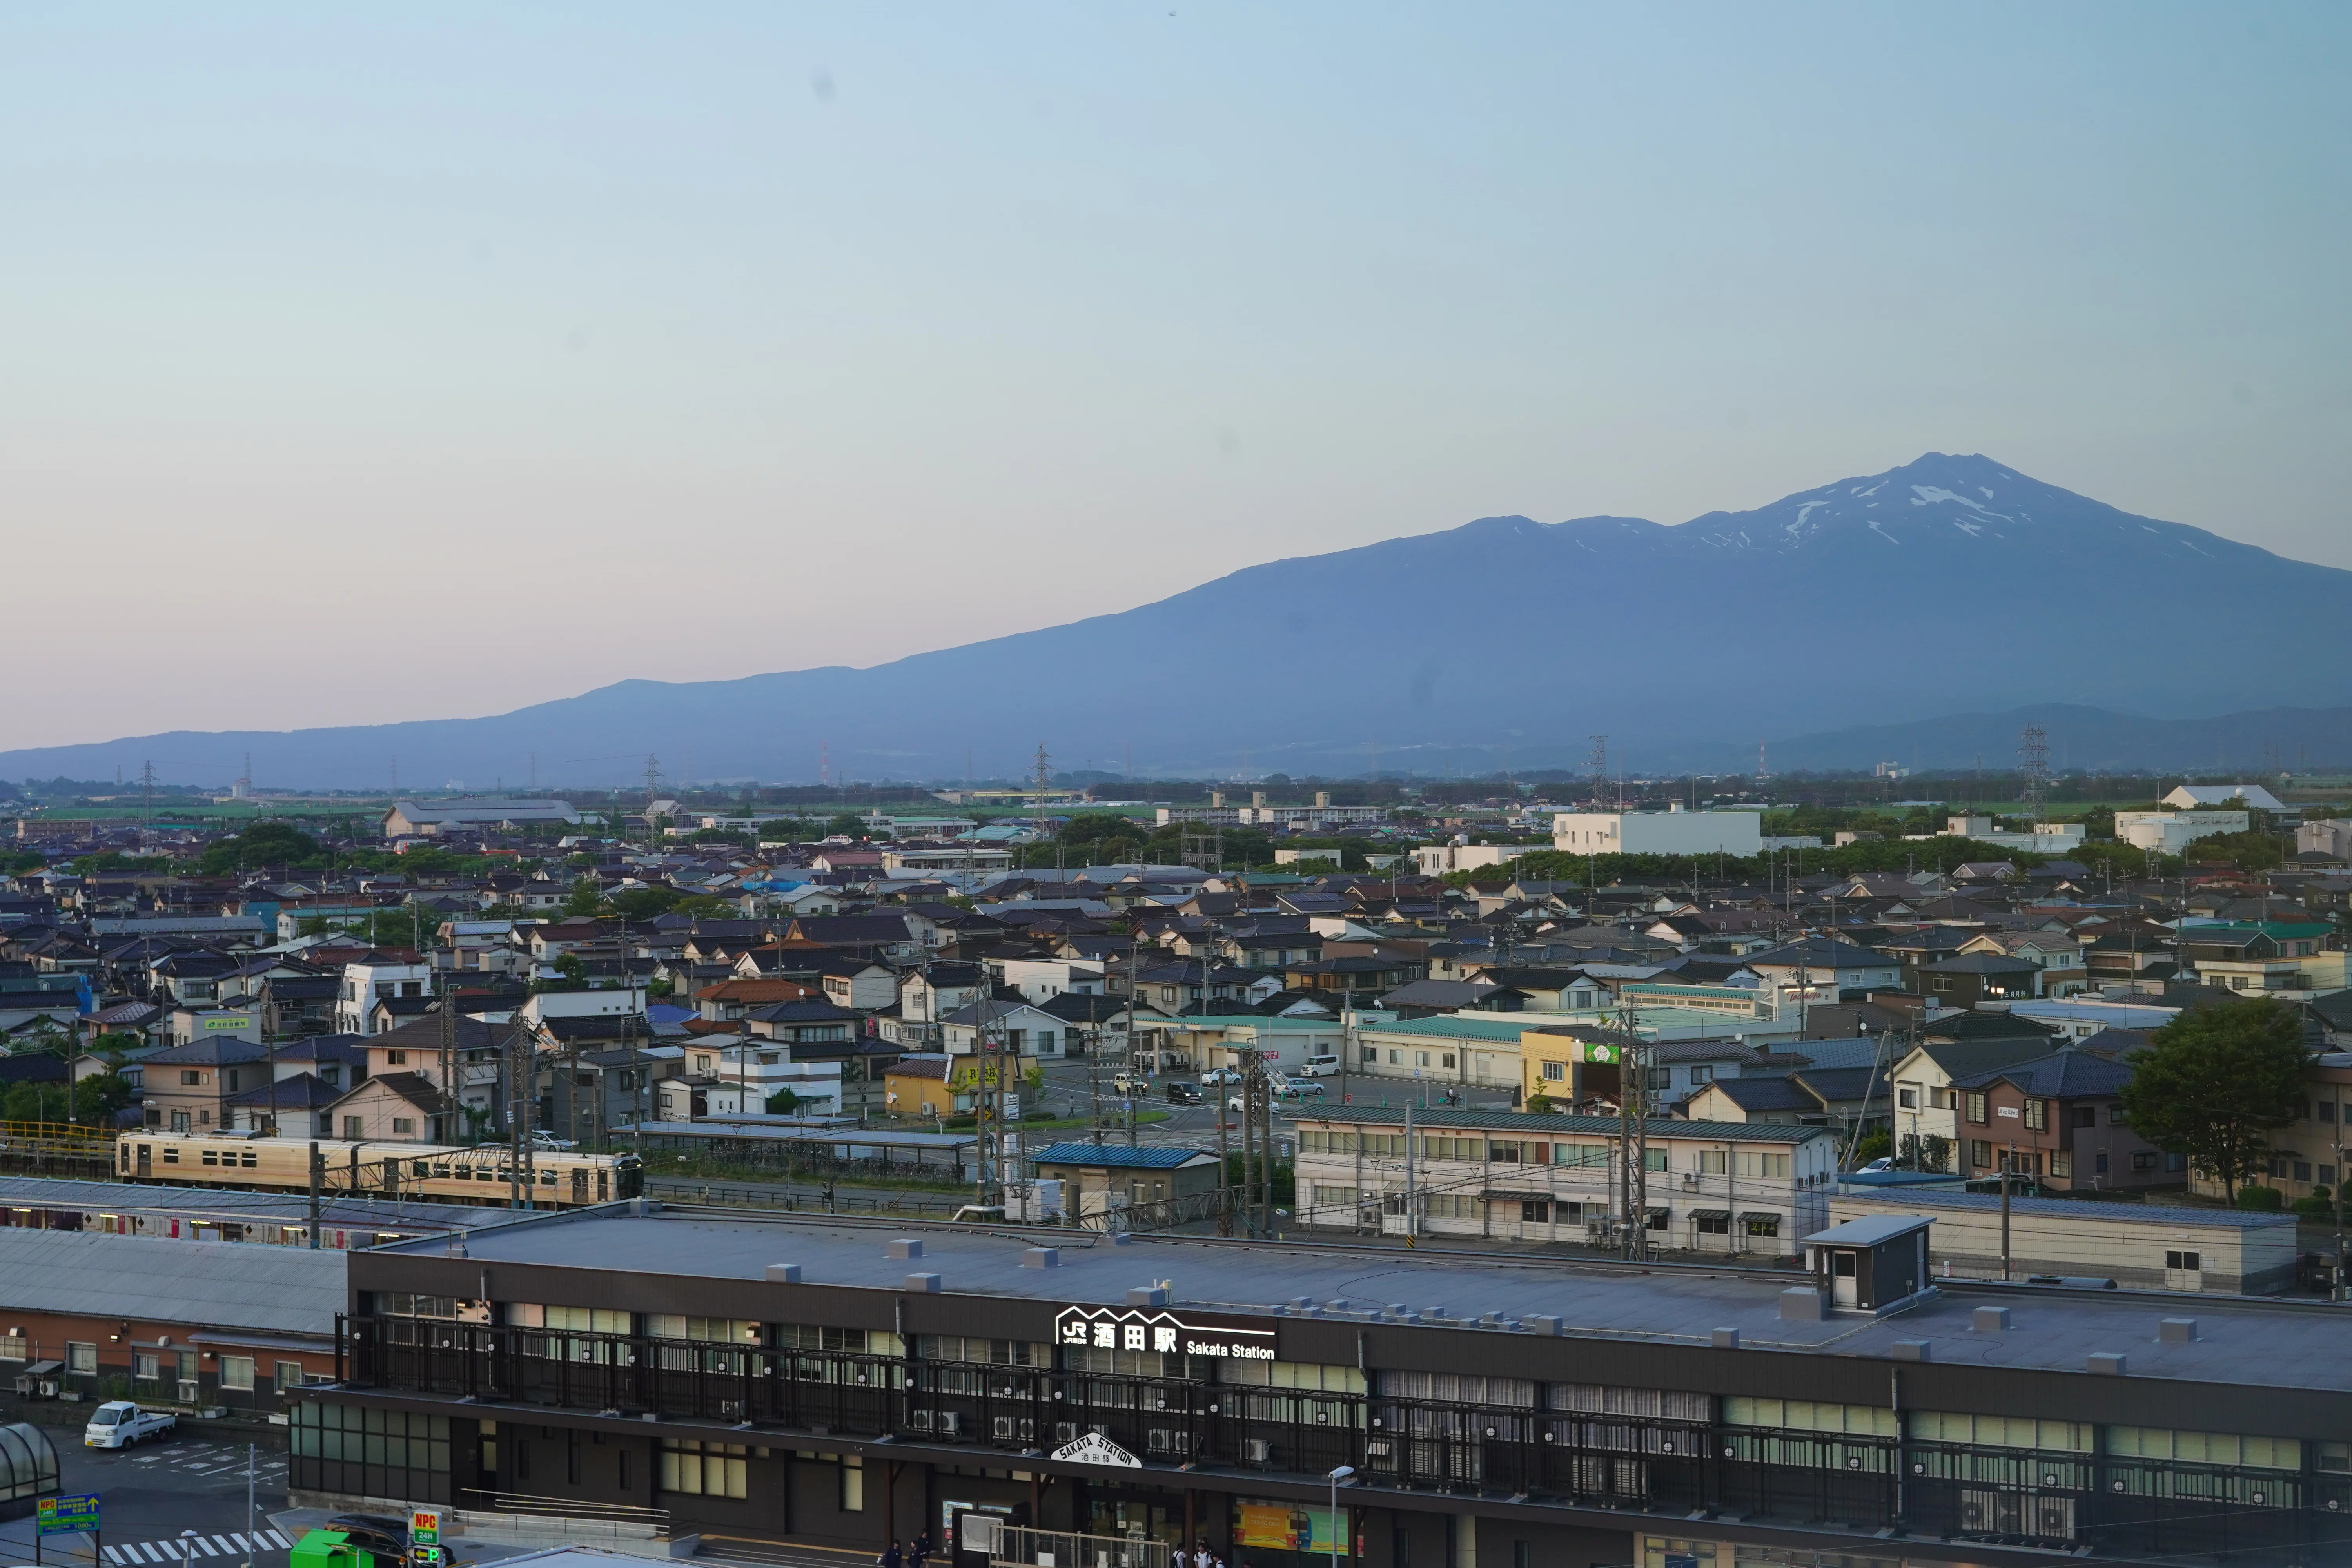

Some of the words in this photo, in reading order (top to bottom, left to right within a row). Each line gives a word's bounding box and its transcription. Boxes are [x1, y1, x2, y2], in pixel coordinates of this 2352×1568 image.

[830, 834, 847, 842] MaxValu
[1786, 990, 1822, 1002] Toihiya
[2004, 990, 2026, 998] 三日月軒
[1063, 1321, 1087, 1338] JR
[1093, 1322, 1177, 1353] 酒田駅
[1187, 1341, 1228, 1356] Sakata
[1232, 1344, 1275, 1360] Station
[1059, 1436, 1093, 1460] SAKATA
[1097, 1437, 1132, 1466] STATION
[40, 1500, 55, 1509] NPC
[416, 1514, 436, 1528] NPC
[419, 1532, 433, 1540] 24H
[428, 1549, 439, 1561] P
